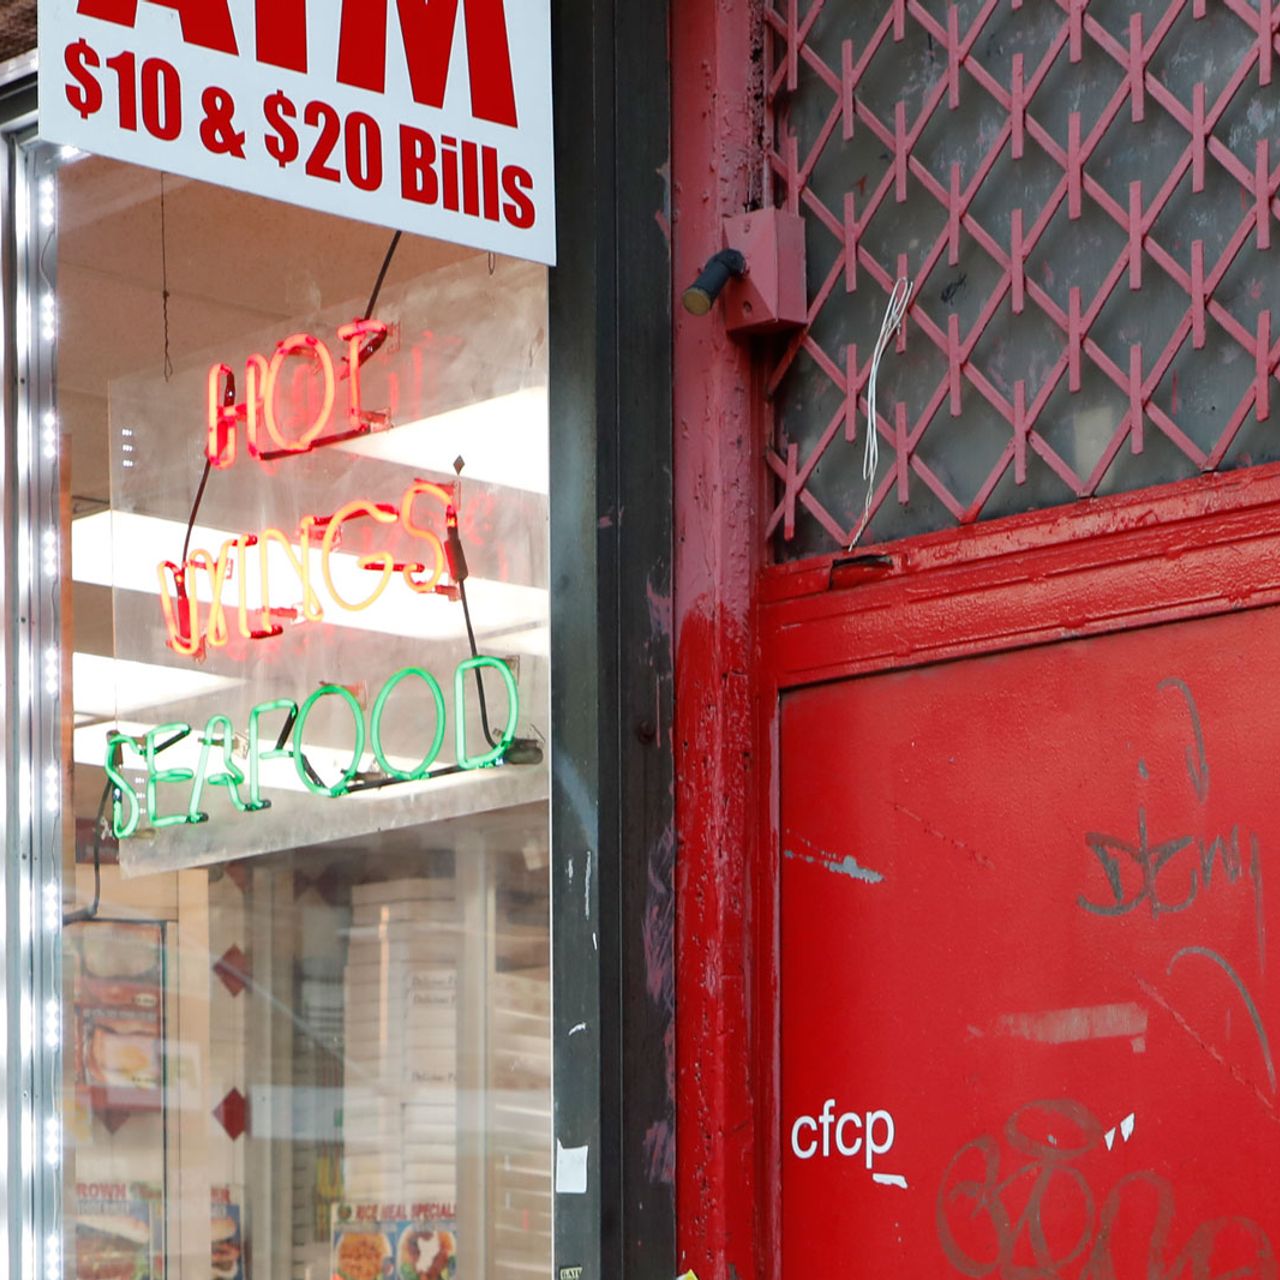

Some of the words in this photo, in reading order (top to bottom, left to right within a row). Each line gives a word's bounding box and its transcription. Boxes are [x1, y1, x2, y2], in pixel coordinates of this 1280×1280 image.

[64, 38, 182, 142] $10
[199, 86, 246, 160] &
[263, 89, 383, 192] $20
[399, 124, 536, 230] Bills
[207, 319, 388, 469] HOT
[158, 483, 456, 656] WINGS
[104, 656, 520, 840] SEAFOOD
[790, 1098, 895, 1170] cfcp
